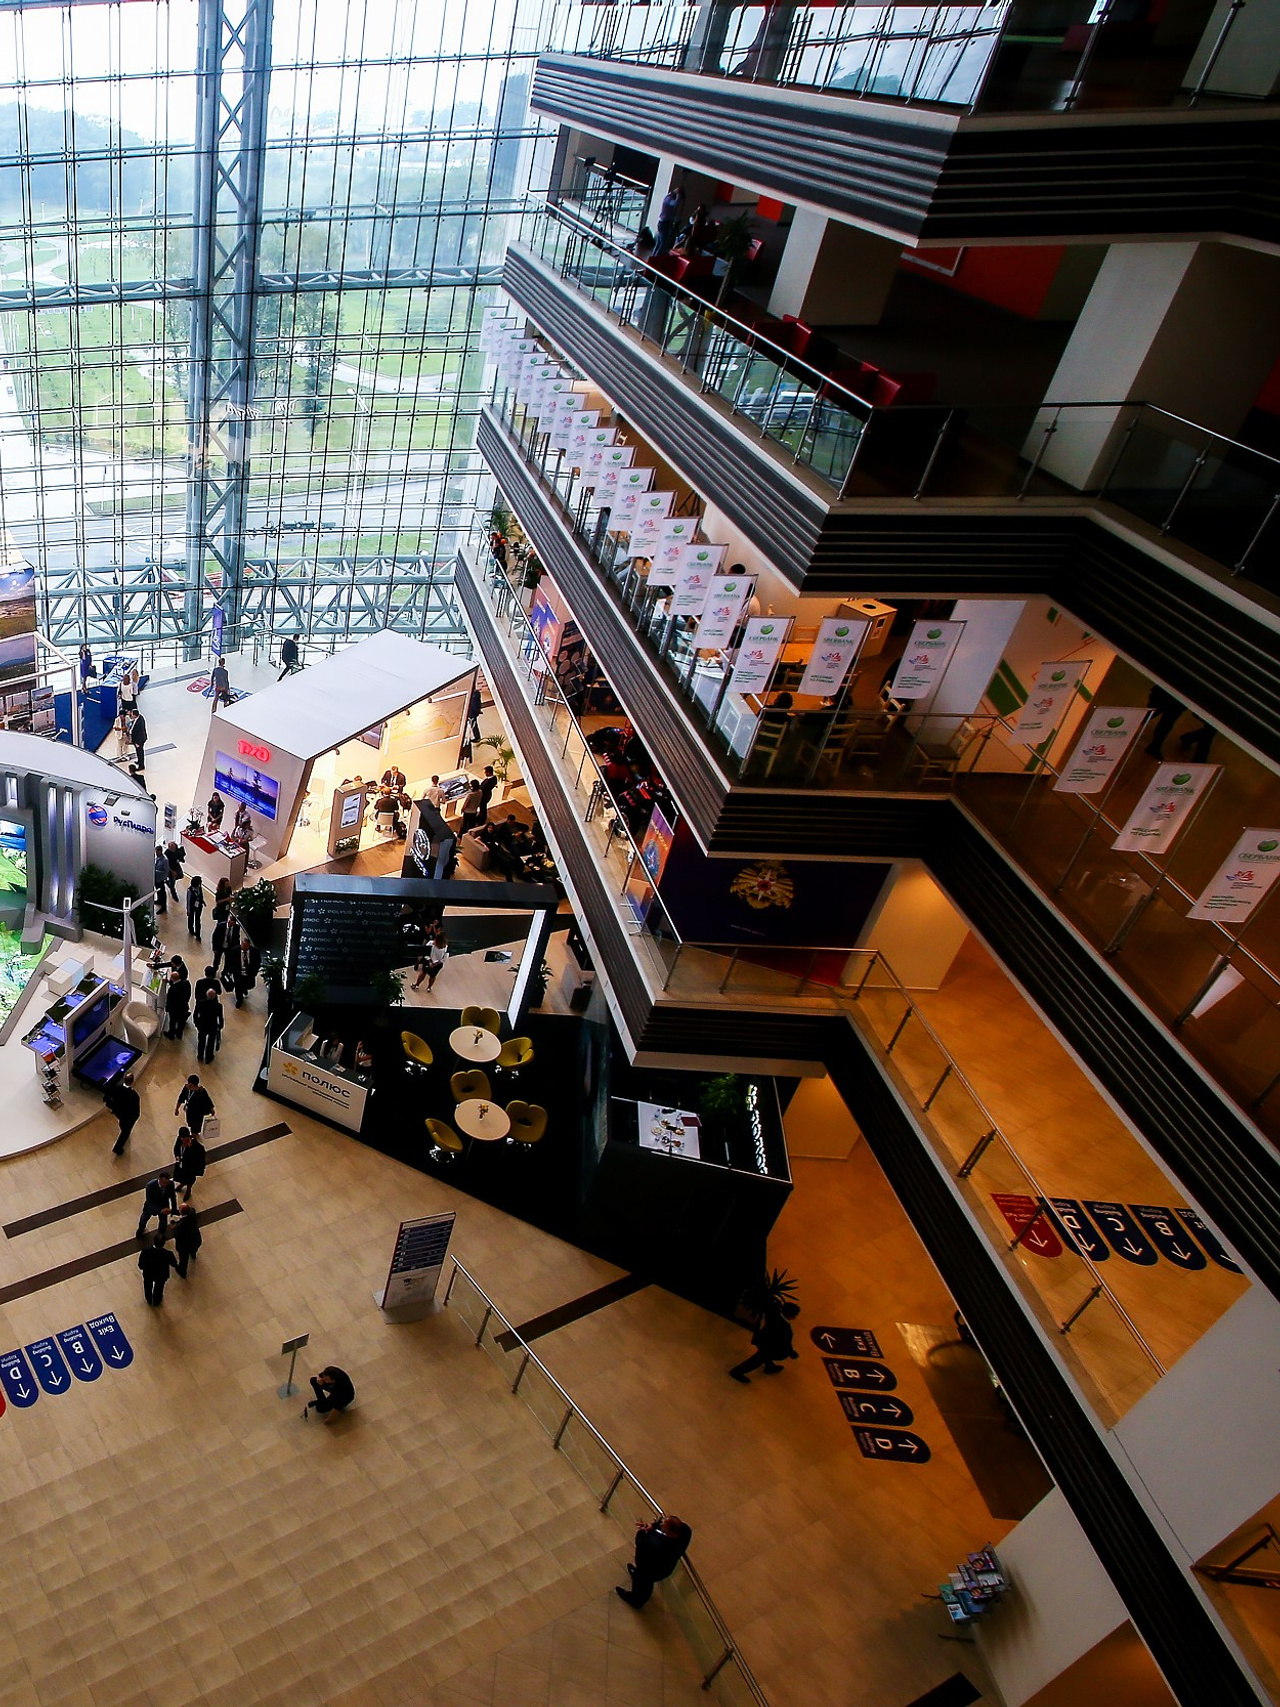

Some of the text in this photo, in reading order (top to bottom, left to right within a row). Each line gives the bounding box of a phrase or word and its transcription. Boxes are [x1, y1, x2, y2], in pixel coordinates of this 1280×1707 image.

[302, 1071, 351, 1098] ПОЛЮС
[1063, 1215, 1081, 1229] D
[1106, 1218, 1126, 1232] C
[1154, 1222, 1175, 1236] B
[89, 1315, 115, 1330] Выход
[97, 1325, 115, 1336] Exit
[72, 1341, 84, 1354] B
[854, 1336, 867, 1351] Exit
[41, 1354, 53, 1367] C
[9, 1367, 22, 1380] D
[843, 1368, 860, 1379] B
[860, 1403, 877, 1413] C
[874, 1437, 893, 1450] D
